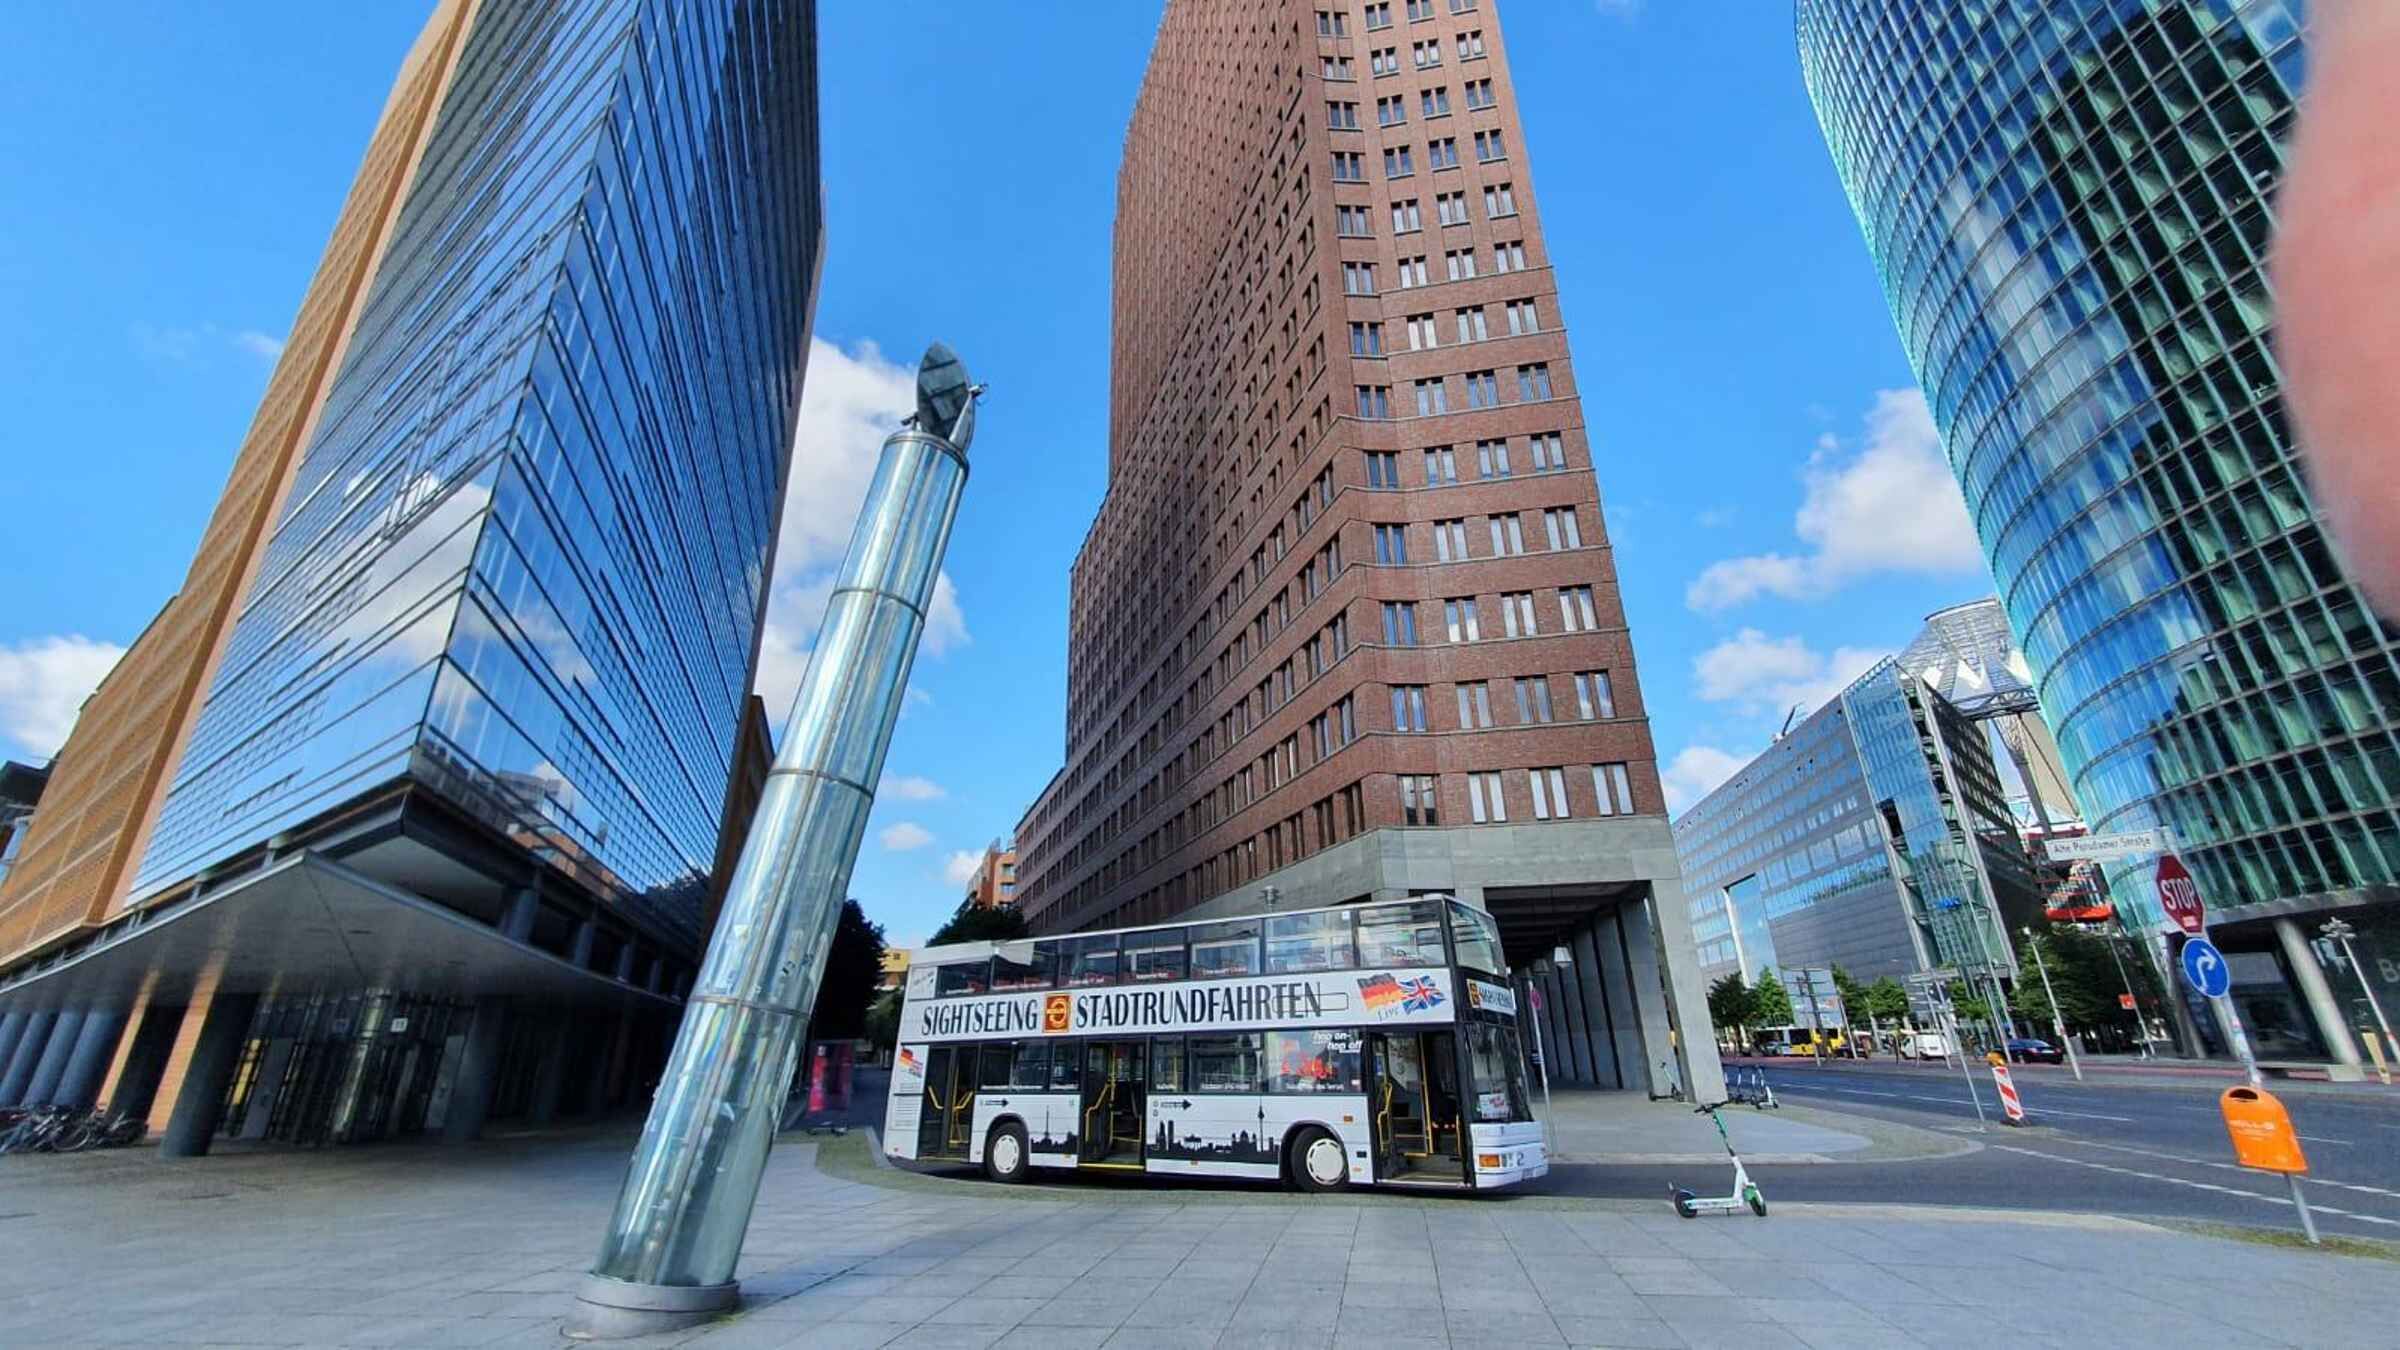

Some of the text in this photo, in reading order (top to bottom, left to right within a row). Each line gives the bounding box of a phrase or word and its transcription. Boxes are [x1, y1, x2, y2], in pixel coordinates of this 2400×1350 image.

[2054, 842, 2070, 853] Alte
[2072, 838, 2118, 852] Potsdamer
[2161, 878, 2197, 910] STOP
[921, 980, 1322, 1036] SIGHTSEEING STADTRUNDFAHRTEN
[1313, 1030, 1333, 1044] hop
